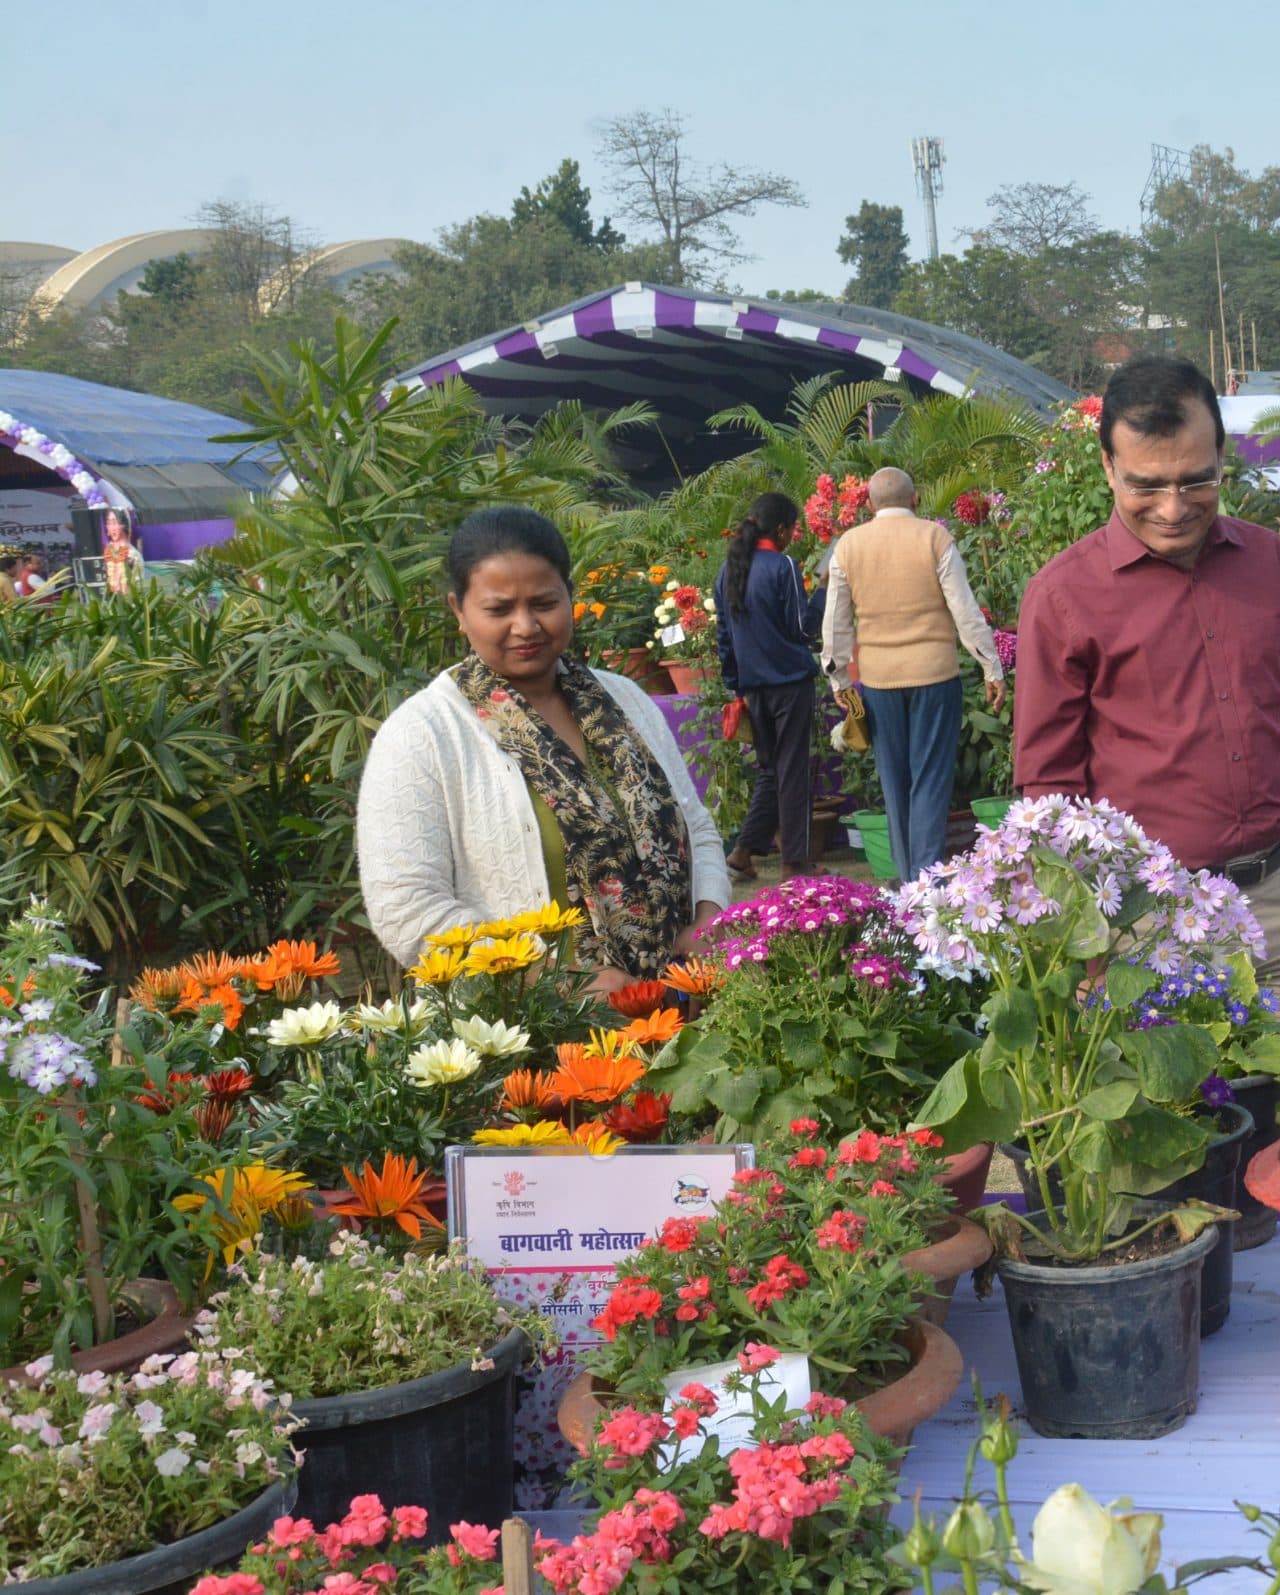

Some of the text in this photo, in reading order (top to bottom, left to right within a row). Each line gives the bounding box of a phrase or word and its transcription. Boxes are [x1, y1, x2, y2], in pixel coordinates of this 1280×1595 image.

[498, 1228, 646, 1252] बागवानी महोत्सव
[541, 1297, 584, 1316] मौसमी
